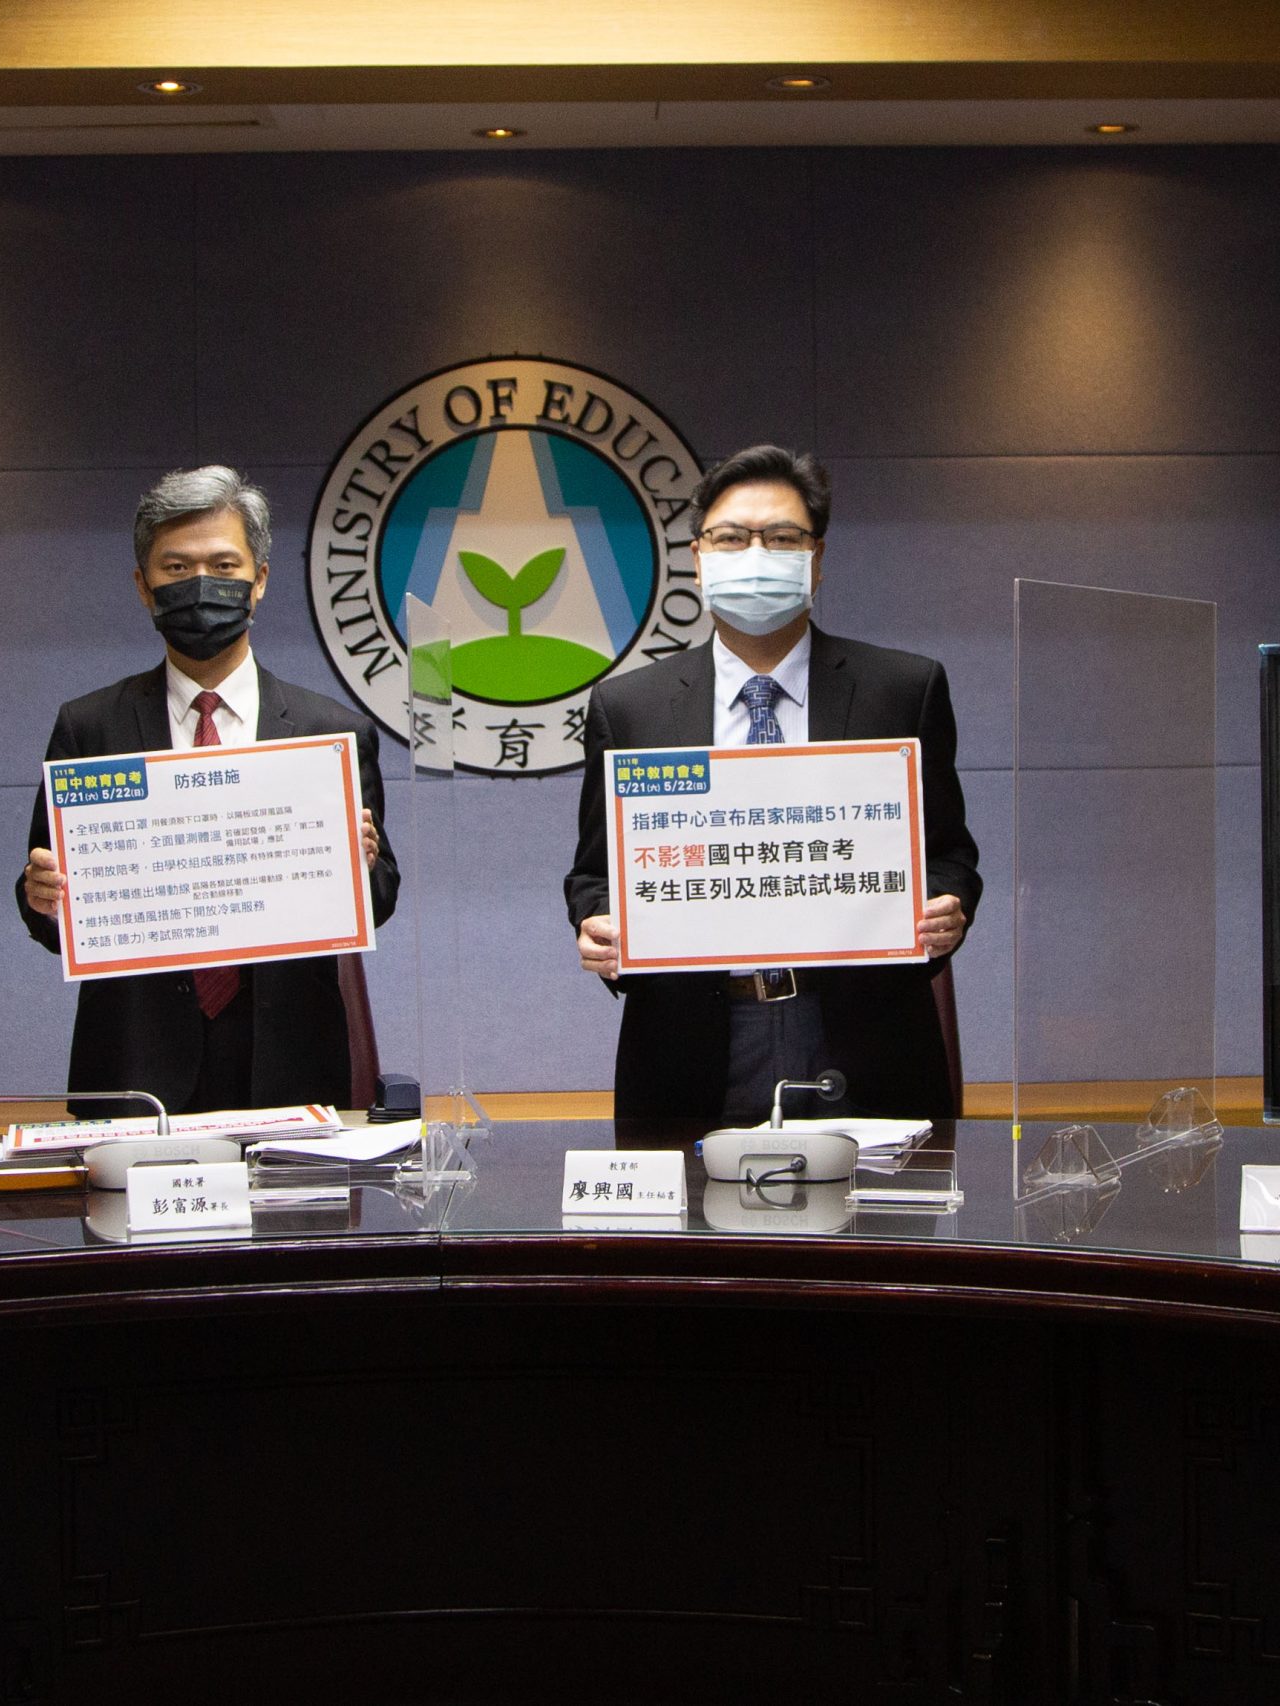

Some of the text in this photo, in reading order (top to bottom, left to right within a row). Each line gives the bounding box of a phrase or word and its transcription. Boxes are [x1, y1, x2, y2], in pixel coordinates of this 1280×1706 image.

[327, 405, 433, 686] MINISTRY
[443, 377, 518, 427] OF
[54, 771, 142, 792] 國中教育會考
[174, 769, 240, 790] 防疫措施
[617, 765, 705, 781] 國中教育會考
[56, 787, 144, 804] 5/21(六) 5/22(日)
[618, 780, 707, 794] 5/21(六) 5/22(日)
[76, 818, 148, 836] 全程佩戴口罩
[632, 802, 902, 831] 指揮中心宣布居家隔離517新制
[78, 830, 222, 855] 進入考場前，全面量測體溫
[634, 838, 855, 869] 不影響國中教育會考
[80, 853, 248, 879] 不開放陪考，由學校組成服務隊
[82, 883, 191, 905] 管制考場進出場動線
[635, 870, 907, 903] 考生匡列及應試試場規劃
[85, 900, 265, 928] 維持適度通風措施下開放冷氣服務
[609, 1161, 639, 1171] 教育部
[569, 1180, 634, 1201] 廖興國
[152, 1196, 208, 1215] 彭富源
